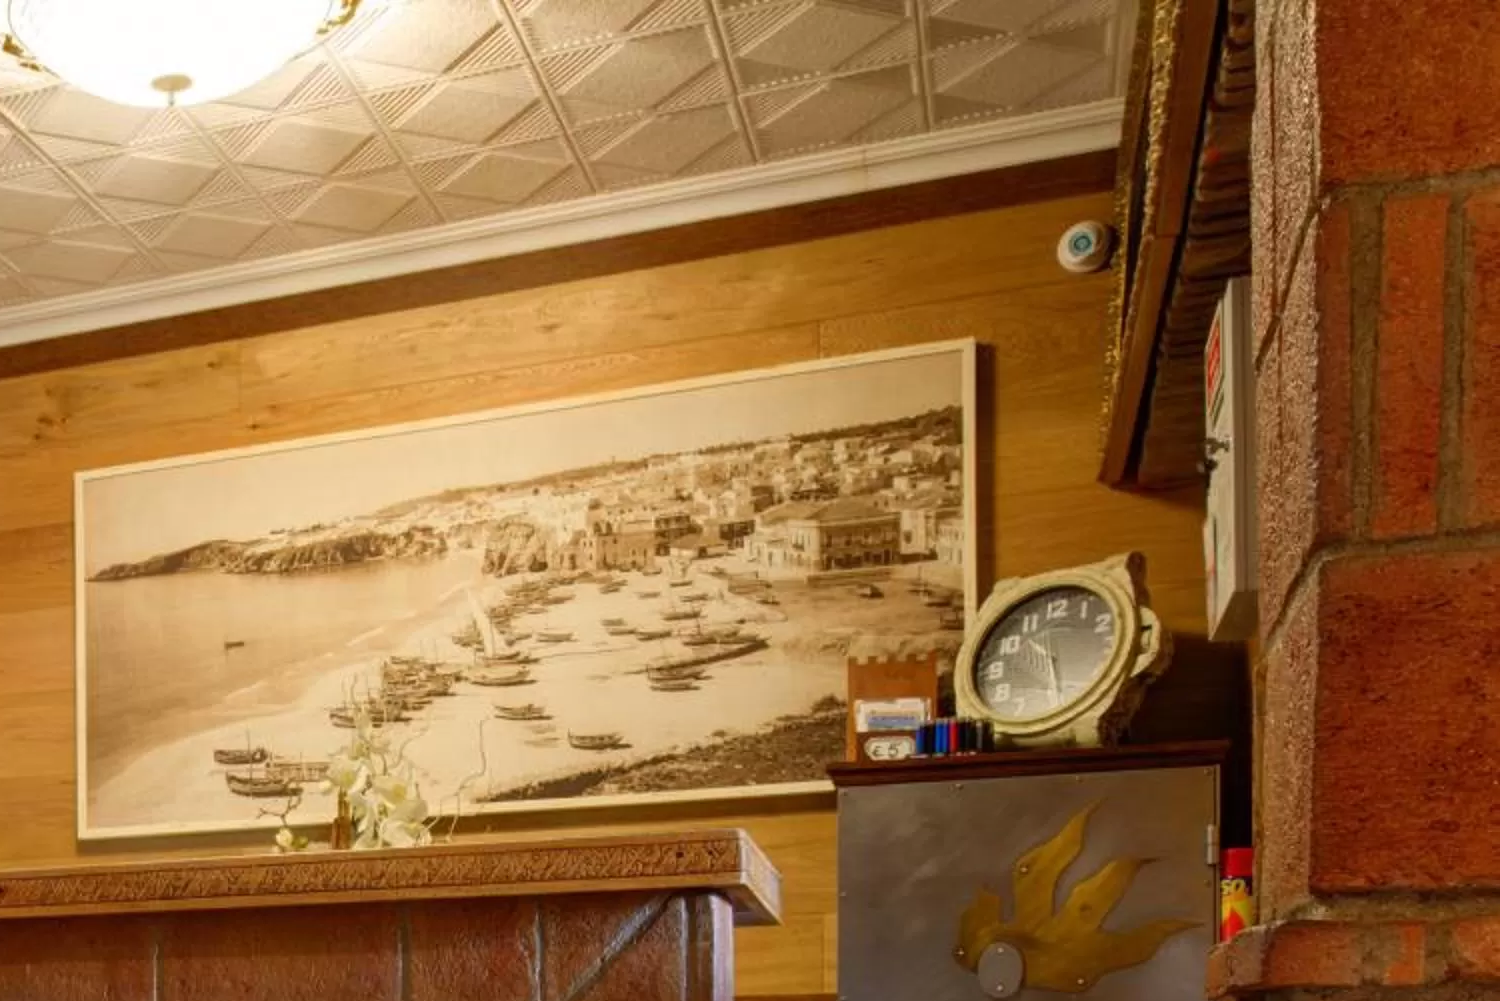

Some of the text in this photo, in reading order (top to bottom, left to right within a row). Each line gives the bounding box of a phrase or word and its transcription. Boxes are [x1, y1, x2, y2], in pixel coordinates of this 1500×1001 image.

[1046, 599, 1068, 620] 12
[1080, 600, 1088, 620] 1
[1022, 613, 1039, 633] 11
[1094, 613, 1112, 633] 2
[1000, 634, 1021, 656] 10
[986, 661, 1004, 680] 9
[994, 683, 1011, 702] 8
